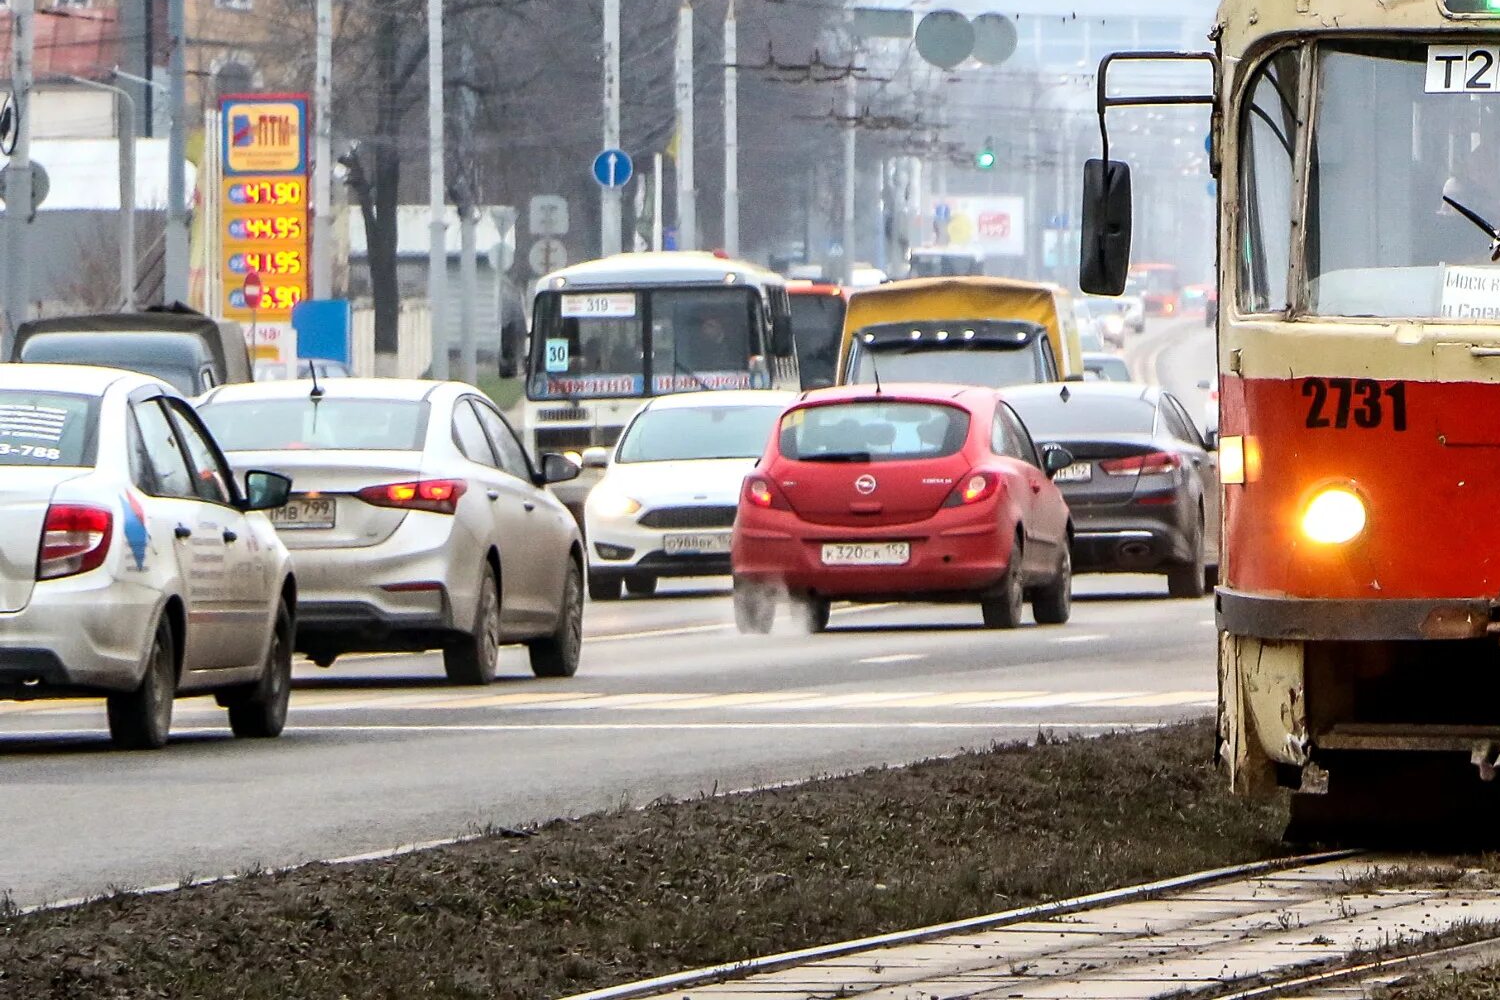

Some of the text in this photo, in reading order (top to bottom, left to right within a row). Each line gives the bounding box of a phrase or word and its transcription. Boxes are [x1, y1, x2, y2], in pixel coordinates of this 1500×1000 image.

[246, 181, 300, 205] 47,90
[246, 217, 300, 239] 44,95
[246, 251, 300, 274] 41,95
[586, 299, 609, 313] 319
[550, 347, 566, 363] 30
[1302, 378, 1406, 432] 2731
[304, 501, 330, 515] 799
